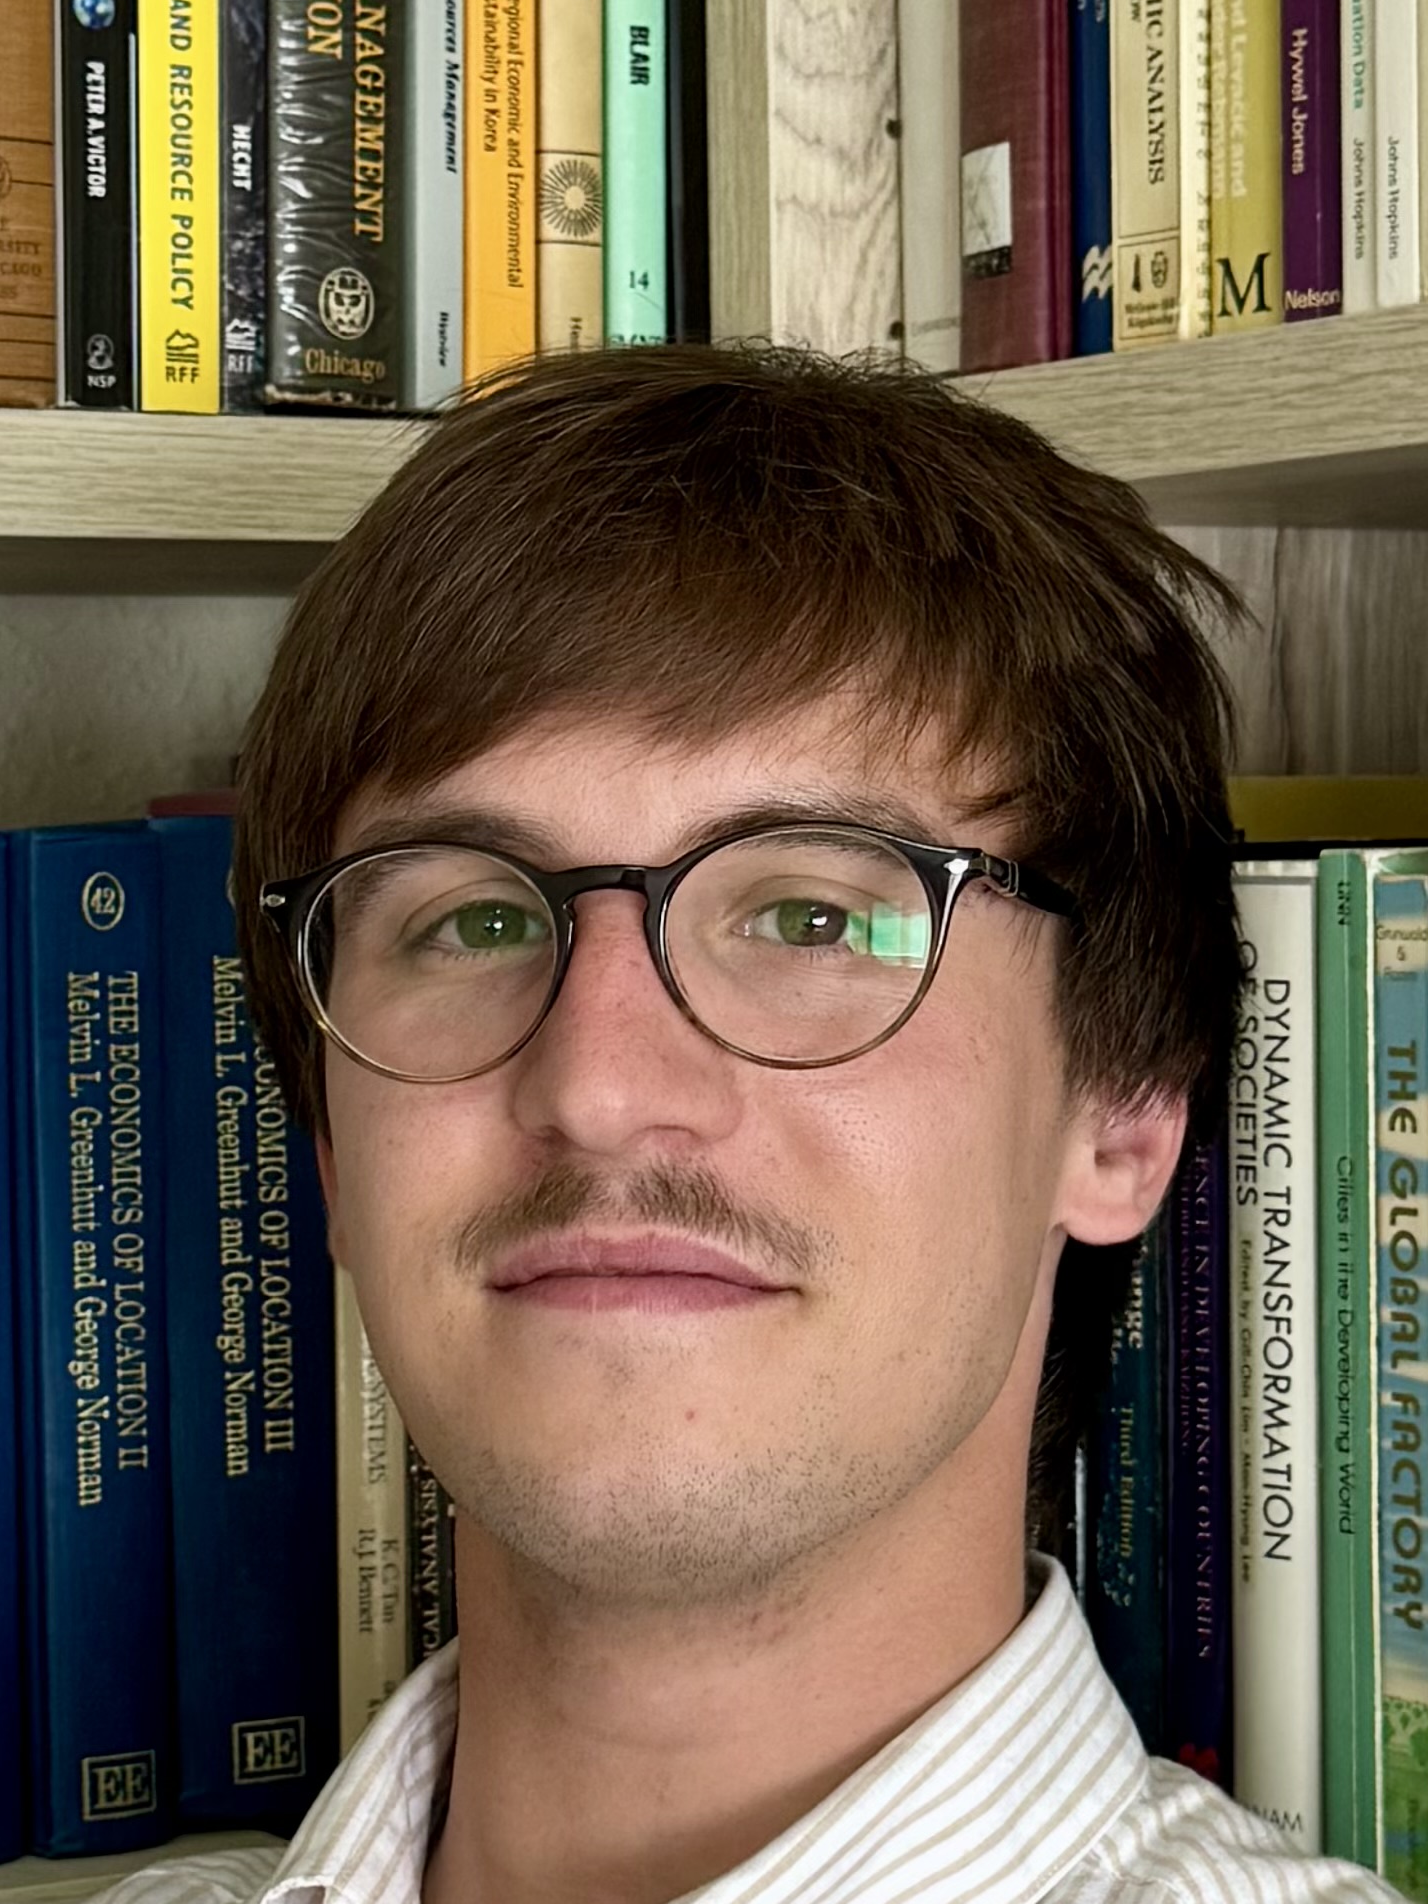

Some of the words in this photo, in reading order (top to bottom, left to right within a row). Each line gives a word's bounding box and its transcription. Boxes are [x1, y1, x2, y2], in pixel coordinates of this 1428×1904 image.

[629, 24, 650, 87] BLAIR
[231, 124, 252, 192] HECHT
[628, 269, 649, 290] 14
[1216, 254, 1272, 318] M
[1285, 289, 1342, 311] Nelson
[166, 359, 199, 384] RFF
[304, 347, 385, 380] Chicago
[90, 888, 115, 914] 42
[1263, 979, 1291, 1171] DYNAMIC
[1386, 1040, 1418, 1135] THE
[1387, 1159, 1422, 1370] GLOBAL
[1263, 1185, 1294, 1562] TRANSFORMATION
[1390, 1391, 1424, 1633] FACTORY
[242, 1727, 297, 1773] EE
[93, 1763, 149, 1810] EE
